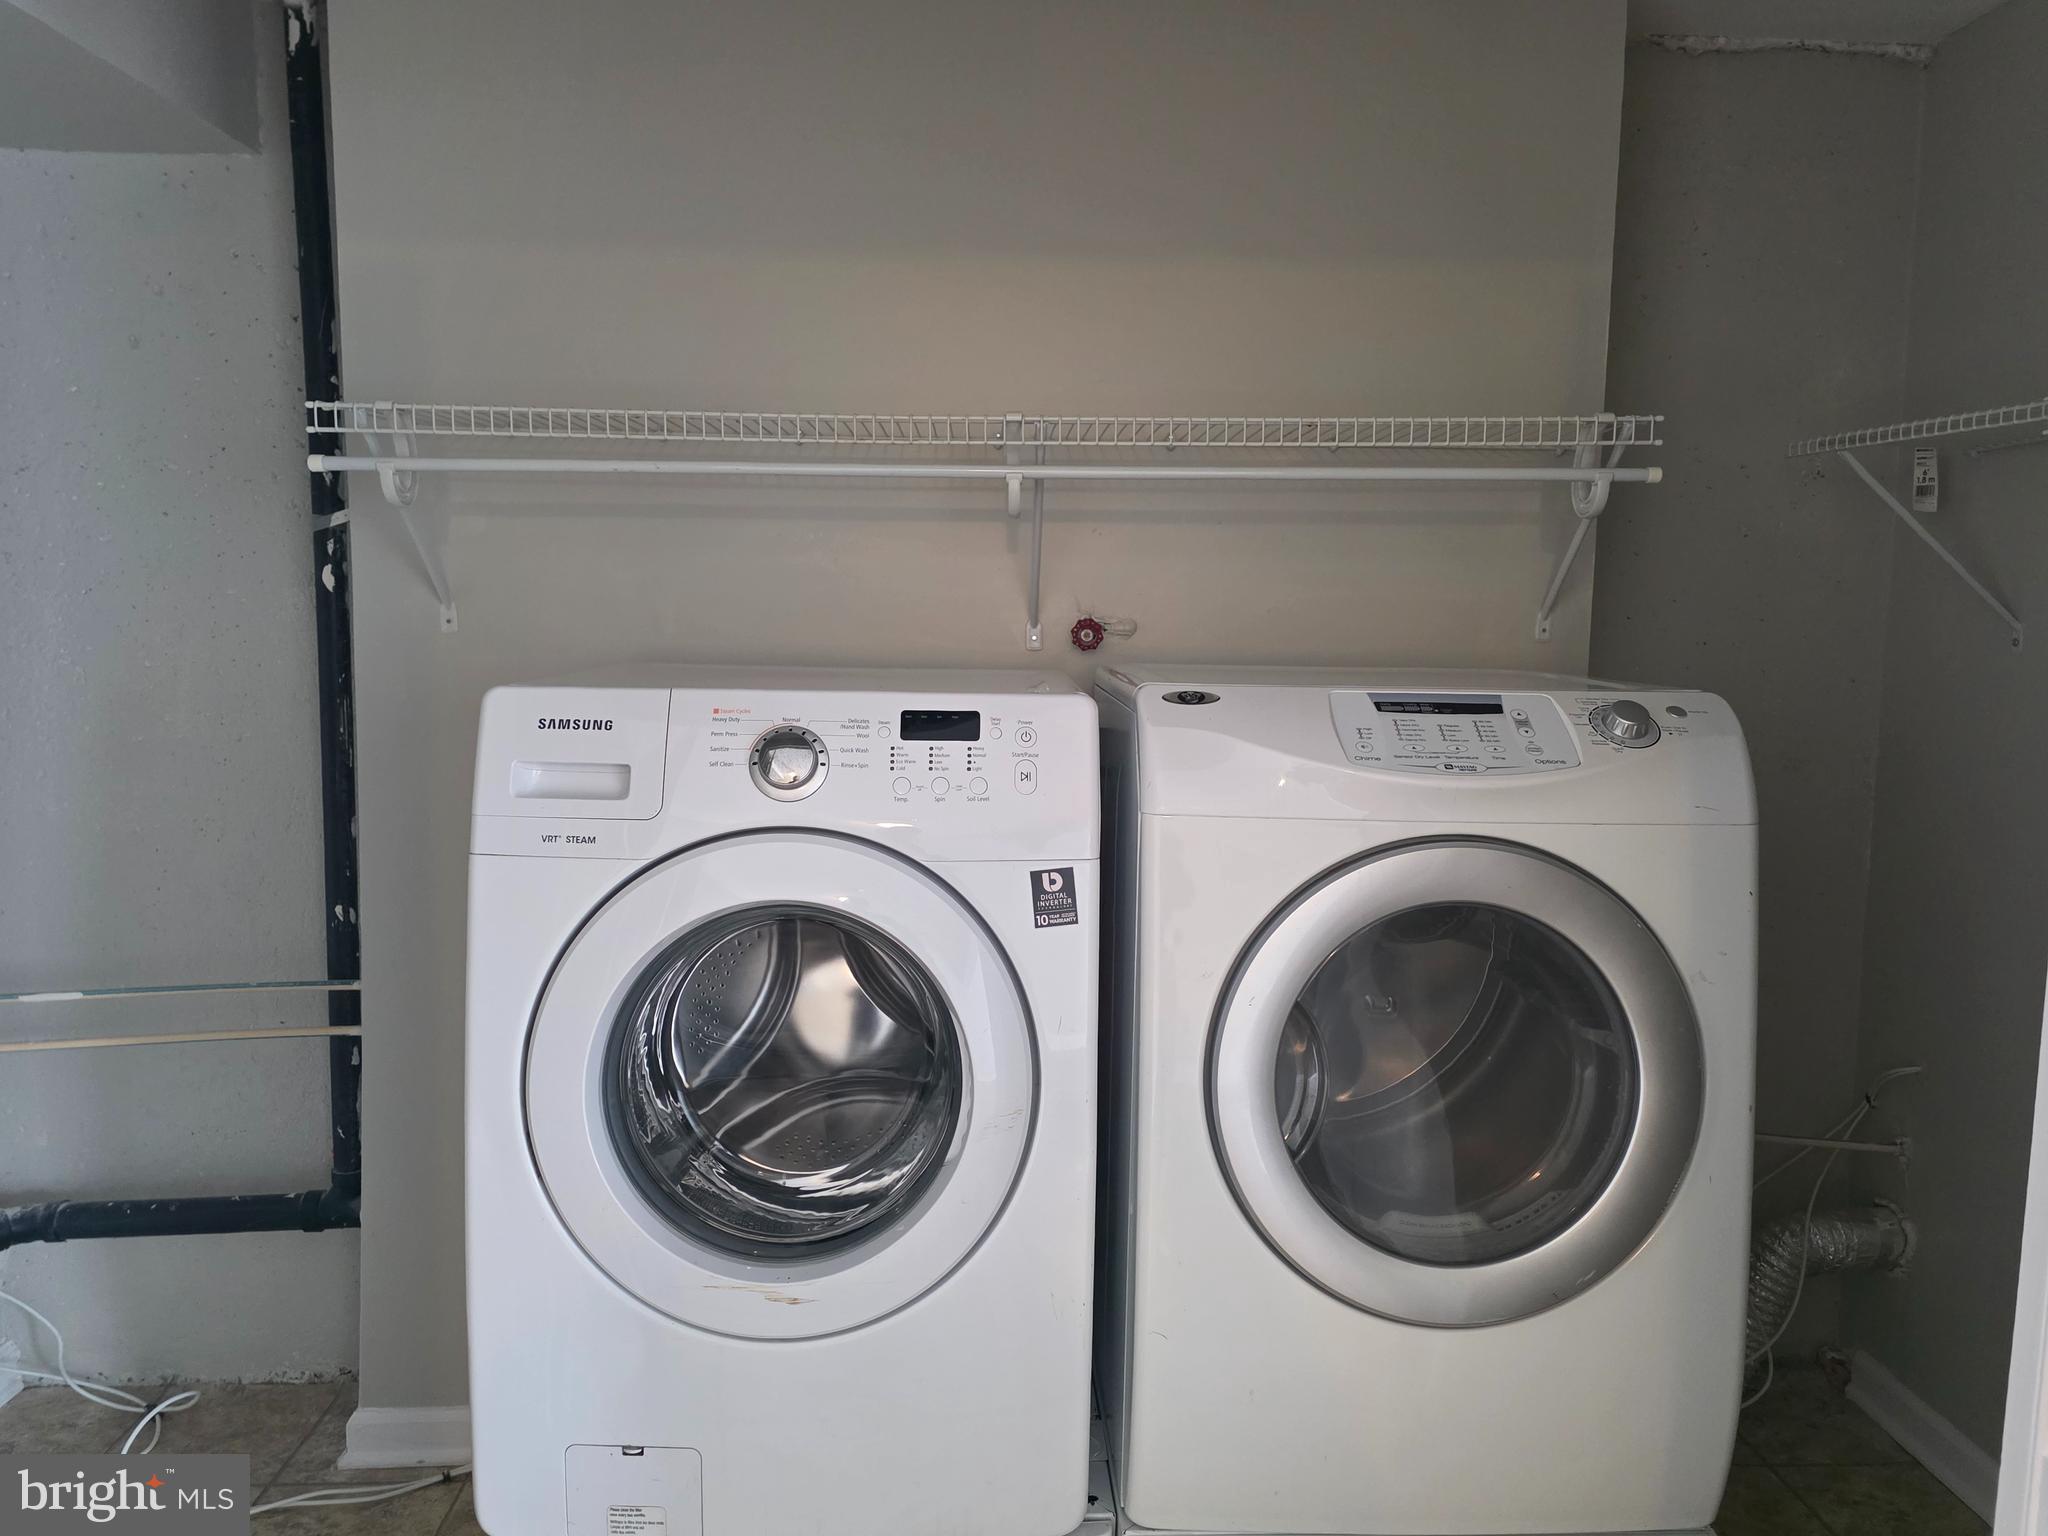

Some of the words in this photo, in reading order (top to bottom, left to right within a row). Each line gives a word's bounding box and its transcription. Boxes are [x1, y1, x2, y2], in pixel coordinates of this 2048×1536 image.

[1917, 476, 1927, 484] 1.8
[538, 718, 613, 731] SAMSUNG
[565, 835, 597, 845] STEAM
[1040, 892, 1067, 900] DIGITAL
[1037, 898, 1072, 907] INVERTER
[1035, 914, 1049, 926] 10
[1049, 916, 1077, 924] WARRANTY
